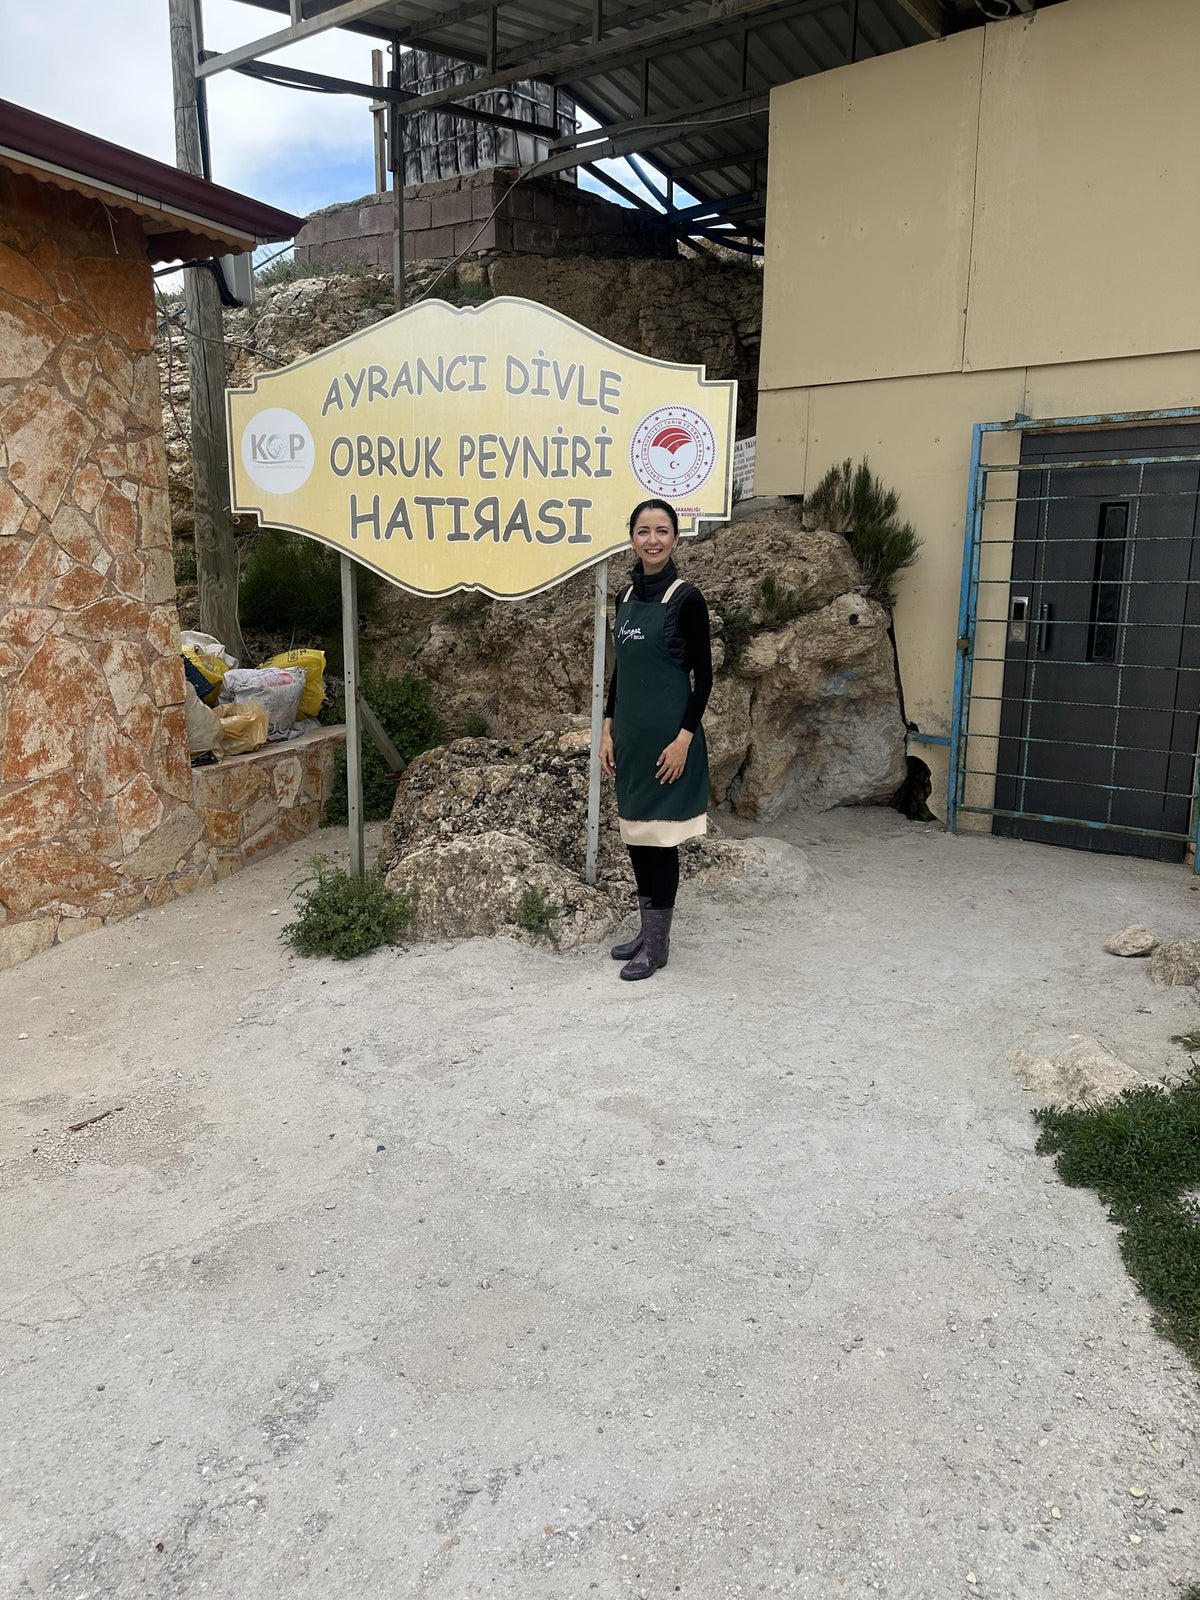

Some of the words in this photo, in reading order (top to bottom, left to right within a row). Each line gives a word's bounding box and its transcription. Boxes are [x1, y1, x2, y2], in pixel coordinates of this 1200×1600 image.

[321, 354, 487, 417] AYRANCI
[505, 349, 622, 415] DİVLE
[251, 433, 306, 461] KOP
[330, 434, 444, 479] OBRUK
[459, 425, 613, 479] PEYNİRİ
